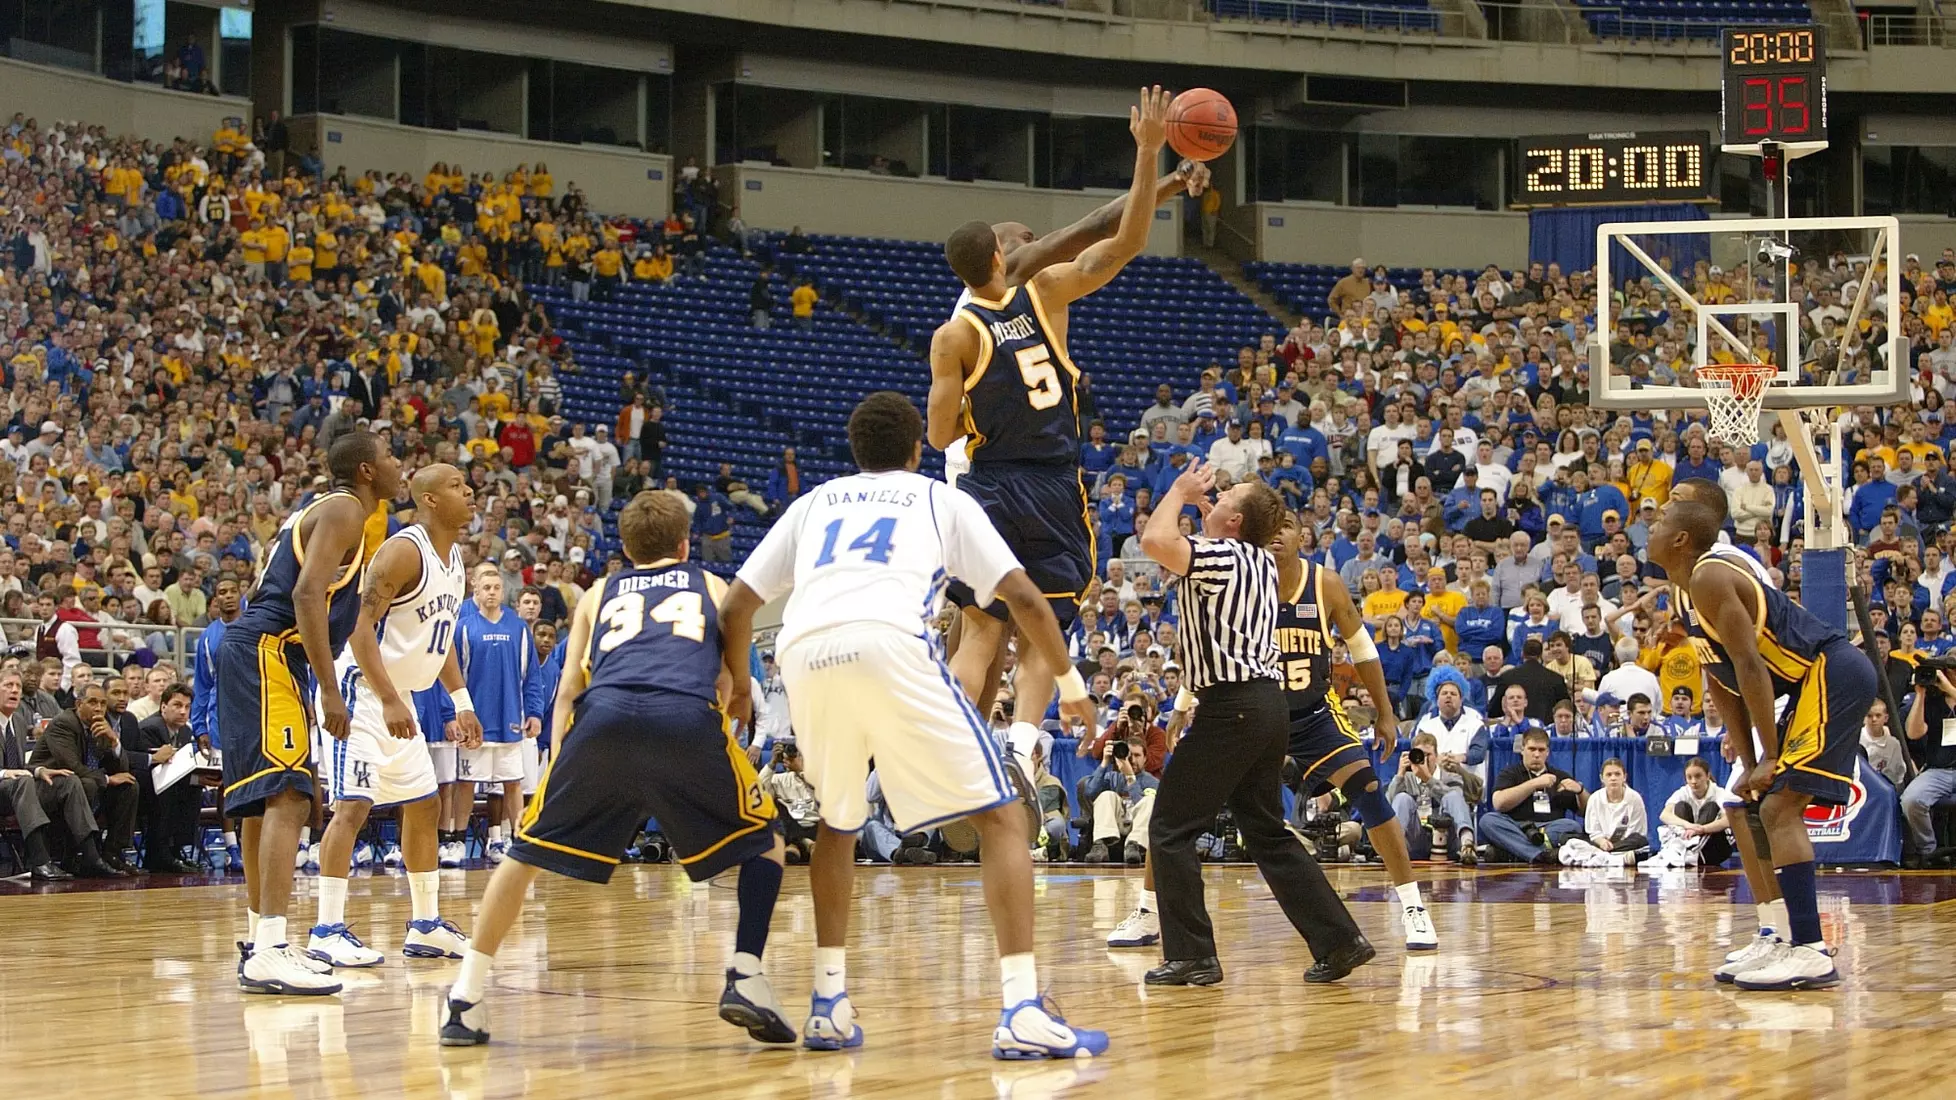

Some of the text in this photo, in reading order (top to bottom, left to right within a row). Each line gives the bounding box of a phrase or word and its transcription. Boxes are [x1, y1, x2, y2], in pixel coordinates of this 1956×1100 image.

[1731, 31, 1813, 64] 20:00
[1743, 77, 1809, 135] 35
[1588, 131, 1636, 140] DAKTRONICS
[1527, 144, 1700, 192] 20:00
[1015, 343, 1063, 410] 5
[826, 490, 917, 507] DANIELS
[813, 517, 898, 569] 14
[617, 570, 690, 596] DIENER
[427, 619, 451, 655] 10
[599, 591, 706, 652] 34
[1276, 658, 1311, 691] 5
[284, 727, 294, 749] 1
[750, 783, 763, 809] 3
